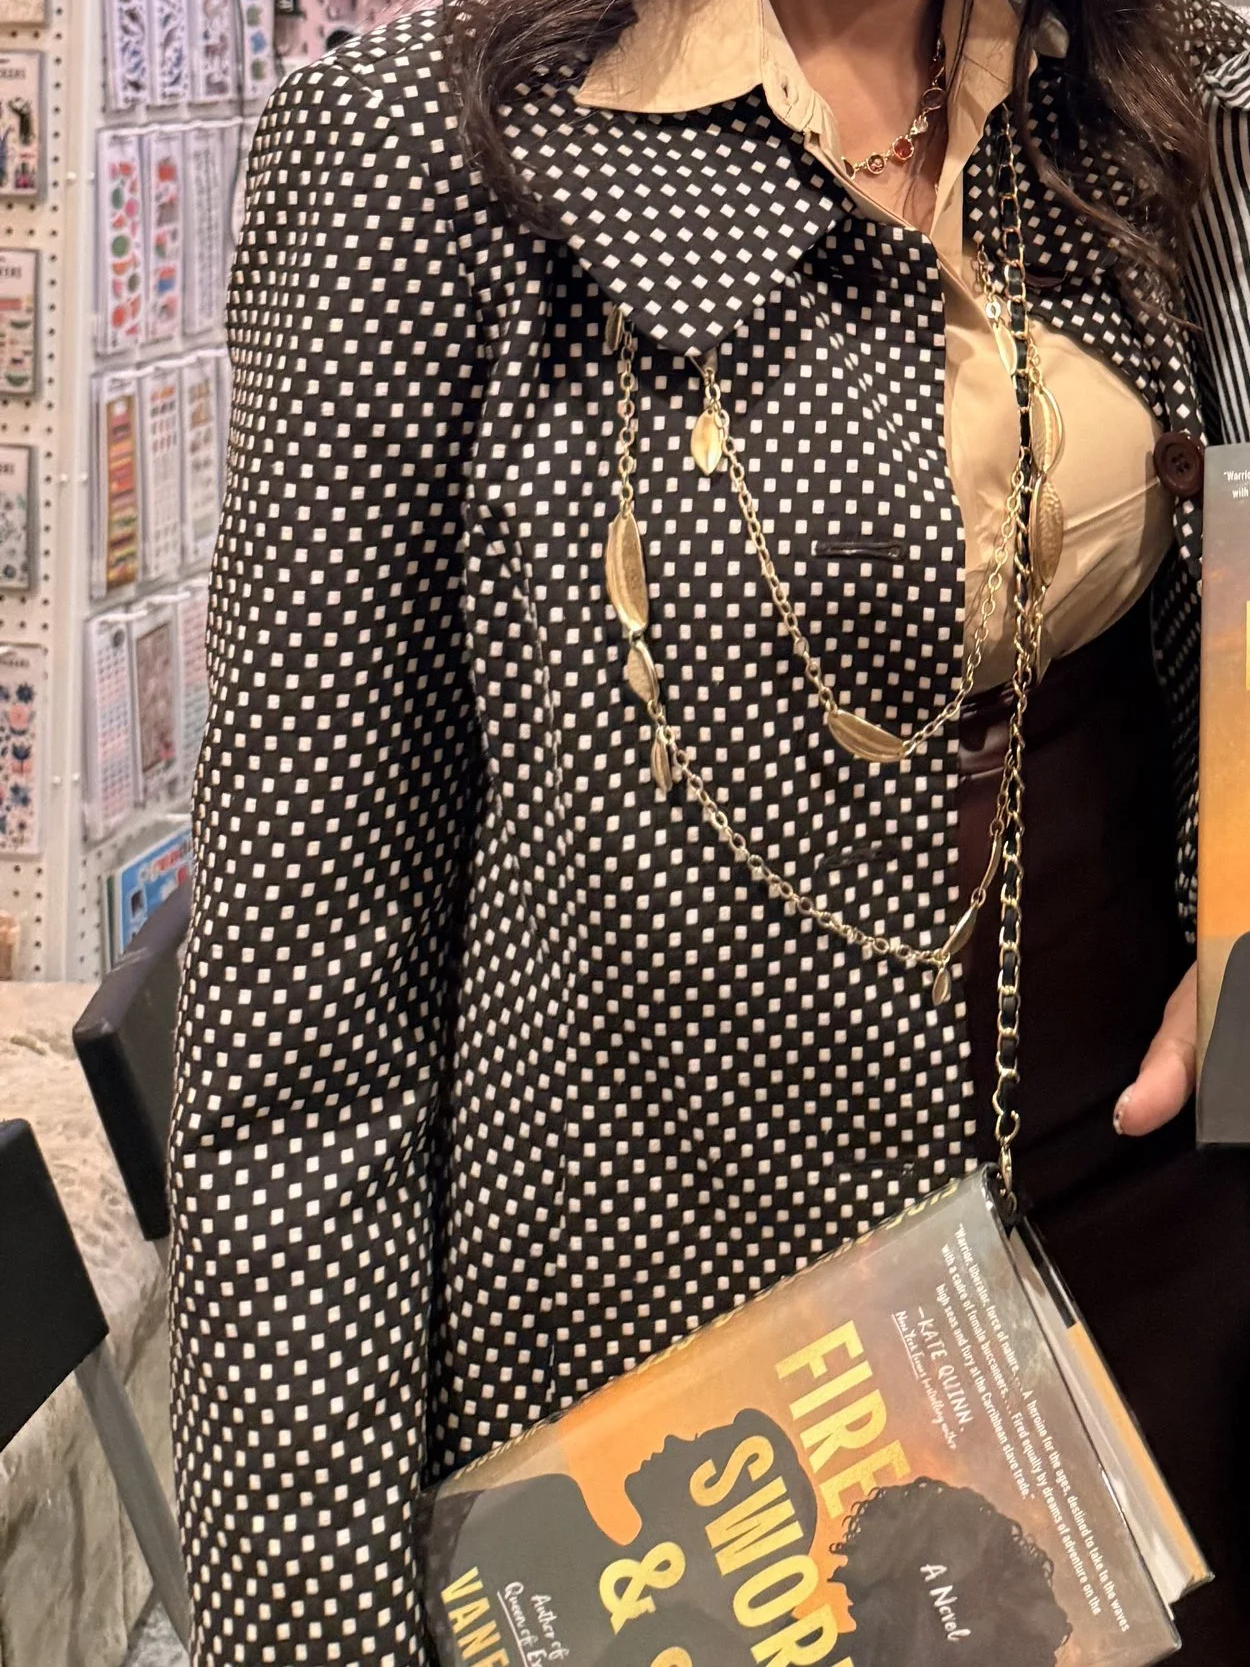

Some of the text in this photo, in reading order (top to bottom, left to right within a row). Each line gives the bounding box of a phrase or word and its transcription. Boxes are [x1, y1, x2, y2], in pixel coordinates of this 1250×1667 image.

[1232, 486, 1248, 498] with
[940, 1243, 956, 1266] with
[948, 1266, 956, 1274] a
[934, 1283, 952, 1306] high
[950, 1272, 968, 1300] cadre
[944, 1305, 959, 1328] seas
[962, 1299, 975, 1311] of
[966, 1310, 987, 1342] female
[985, 1305, 1002, 1331] force
[952, 1327, 968, 1346] and
[996, 1330, 1010, 1342] of
[959, 1344, 976, 1366] fury
[969, 1366, 982, 1378] at
[974, 1376, 988, 1394] the
[1022, 1390, 1034, 1400] A
[775, 1319, 912, 1519] FIRE
[1010, 1412, 1030, 1438] Fired
[1026, 1399, 1048, 1436] heroine
[1042, 1436, 1055, 1452] for
[1002, 1443, 1020, 1470] slave
[1020, 1438, 1044, 1474] equally
[1048, 1450, 1062, 1468] the
[1034, 1471, 1049, 1487] by
[1042, 1486, 1064, 1523] dreams
[1066, 1494, 1092, 1537] destined
[1057, 1522, 1070, 1534] of
[689, 1435, 855, 1667] SWOR
[1084, 1535, 1096, 1548] to
[1062, 1534, 1089, 1584] adventure
[1089, 1546, 1105, 1570] take
[1098, 1569, 1110, 1582] to
[599, 1541, 686, 1635] &
[1082, 1583, 1094, 1598] on
[1102, 1580, 1118, 1600] the
[504, 1581, 528, 1630] Queen
[919, 1563, 971, 1643] A Novel
[1088, 1596, 1102, 1614] the
[1110, 1598, 1130, 1632] waves
[530, 1593, 558, 1640] Author
[547, 1640, 570, 1661] of
